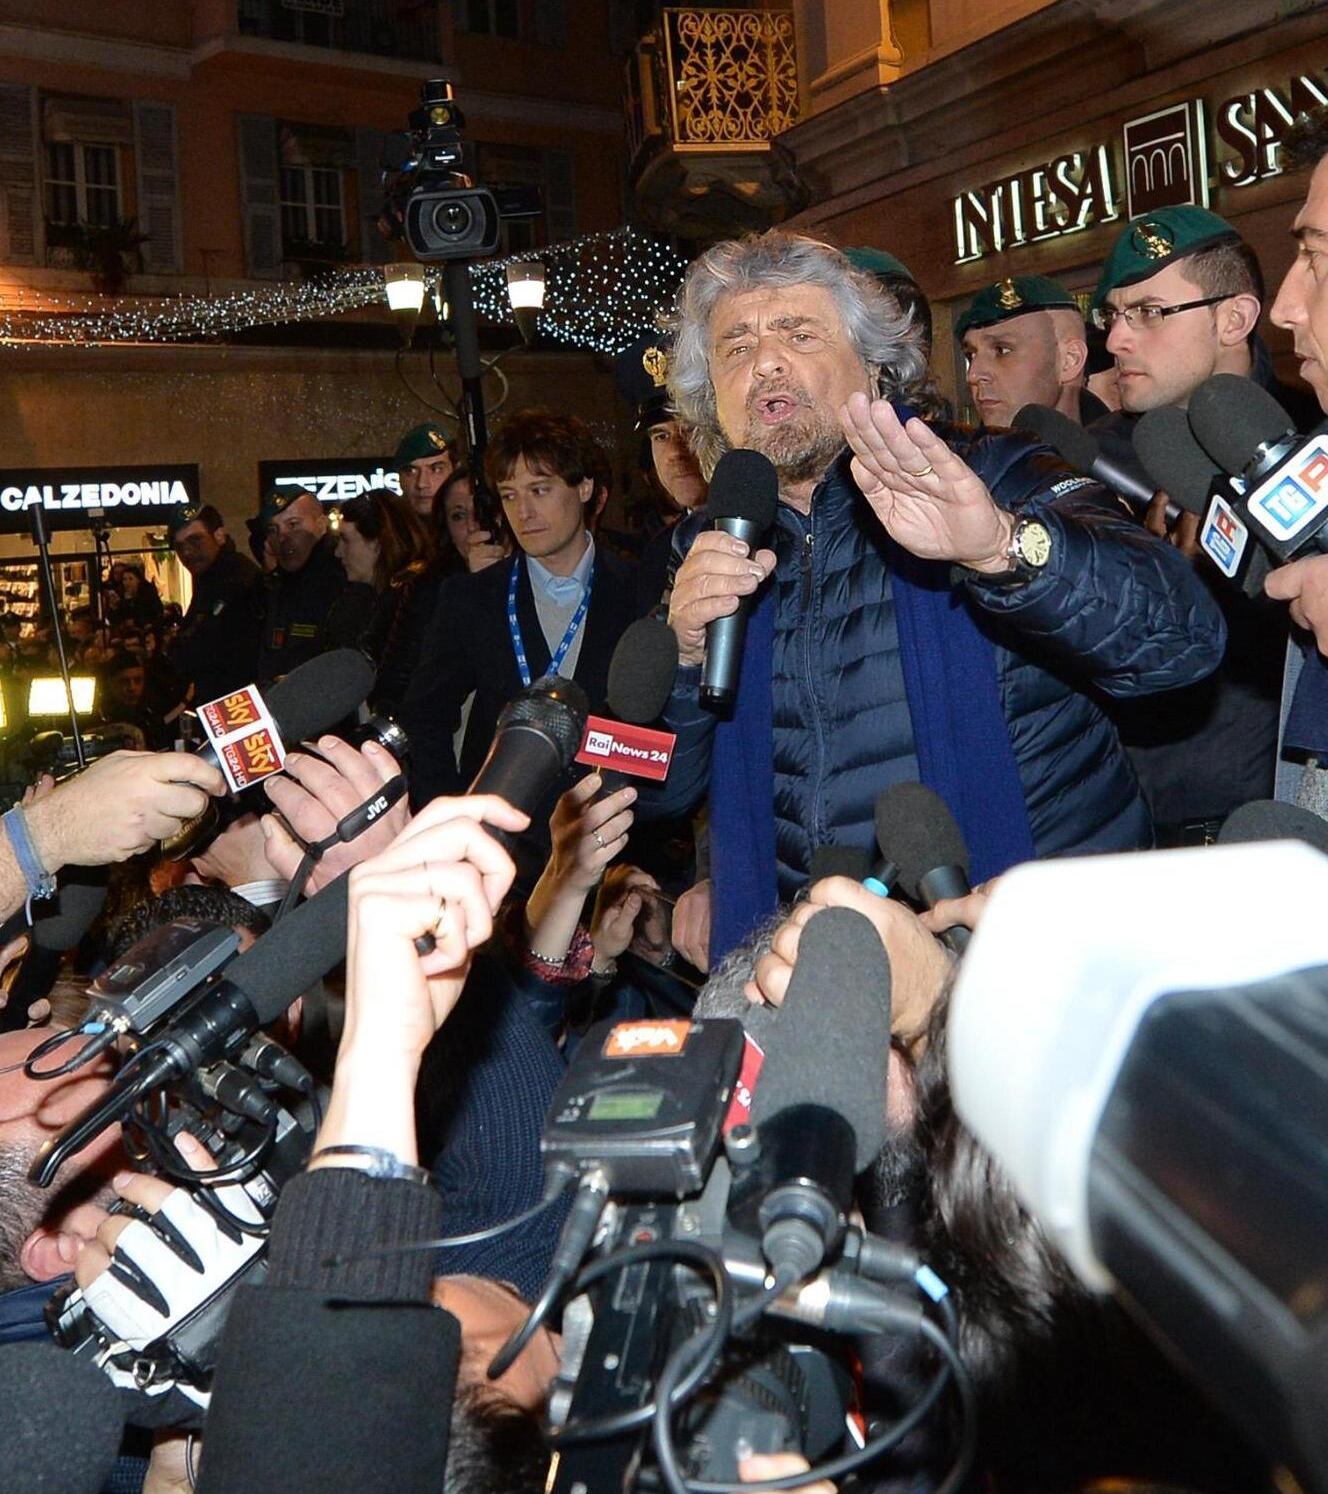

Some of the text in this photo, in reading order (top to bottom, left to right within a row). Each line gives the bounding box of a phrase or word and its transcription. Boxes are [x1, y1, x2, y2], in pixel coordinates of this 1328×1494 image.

[954, 143, 1121, 265] INTESA
[0, 480, 190, 511] CALZEDONIA
[223, 694, 254, 725] sky
[242, 733, 276, 774] sky
[588, 737, 668, 764] Rai News 24
[366, 795, 388, 820] JVC
